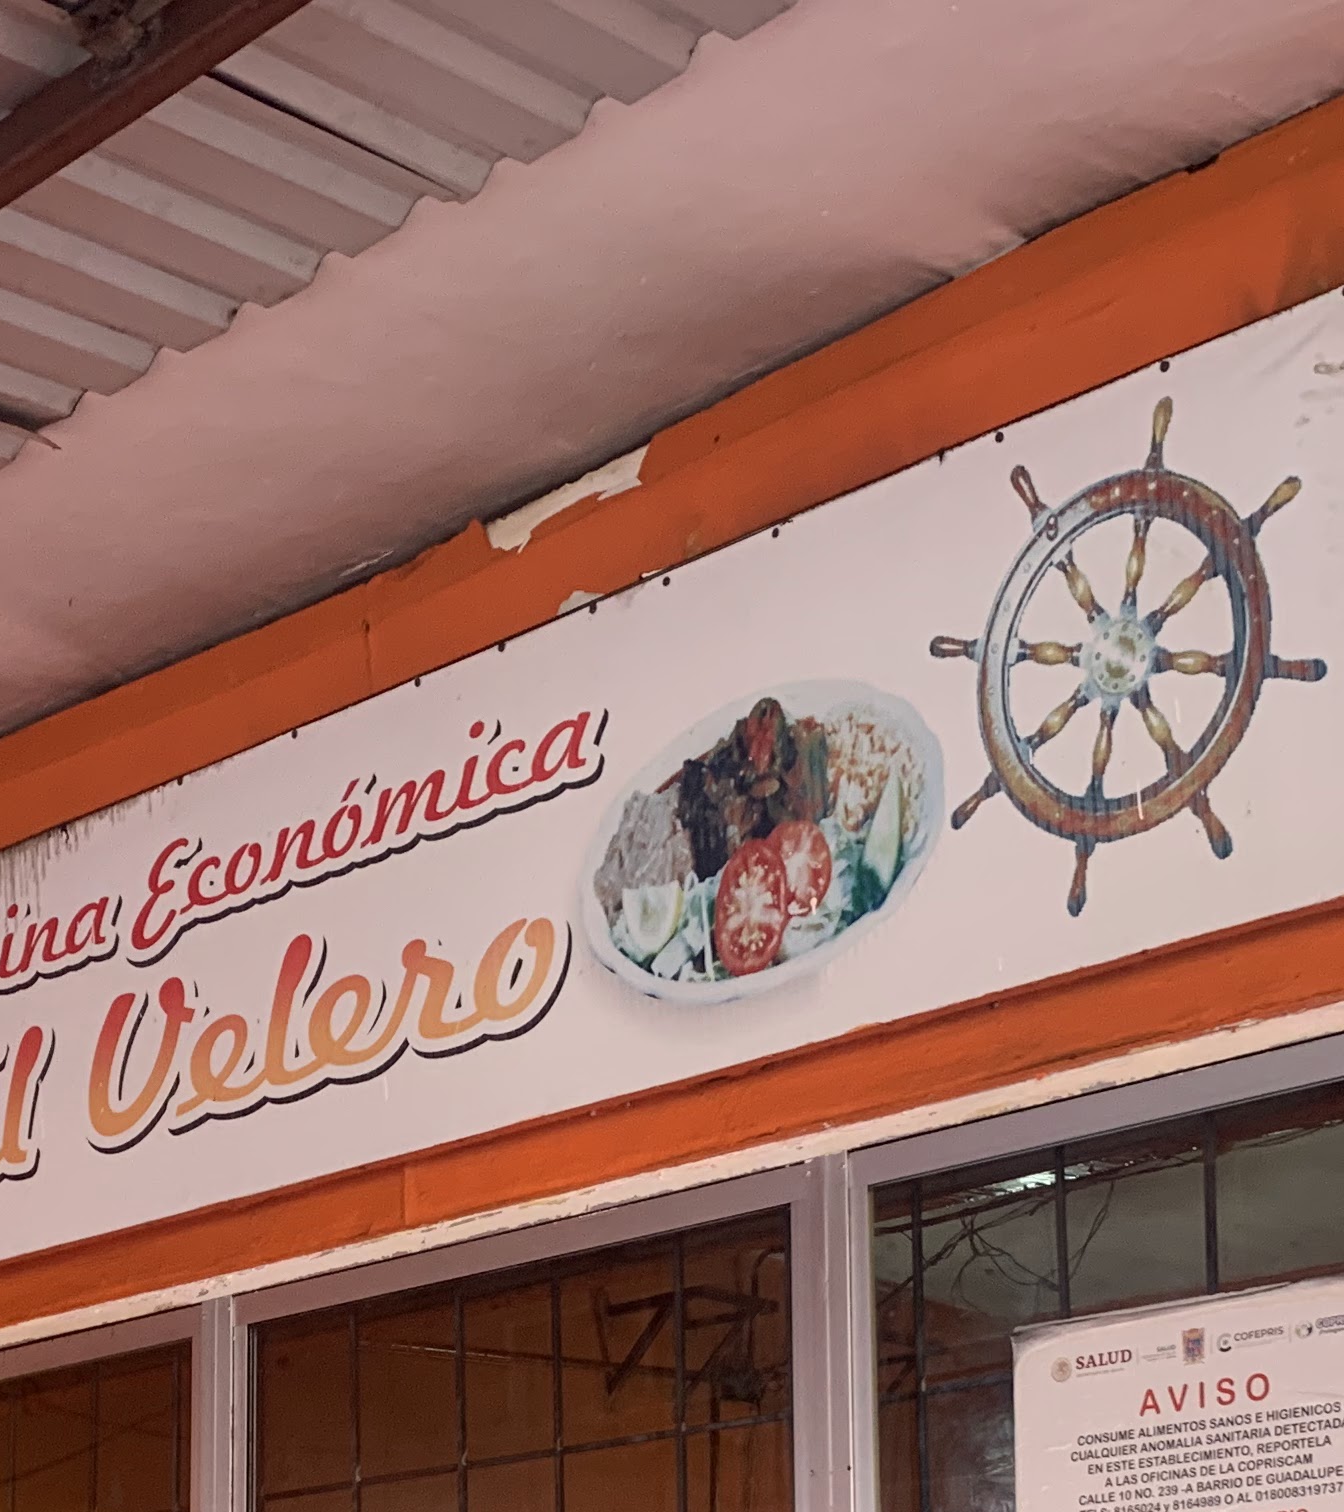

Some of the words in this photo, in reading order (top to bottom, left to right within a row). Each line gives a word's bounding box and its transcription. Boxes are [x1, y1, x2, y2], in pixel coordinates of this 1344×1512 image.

[127, 708, 608, 966] Económica
[86, 916, 571, 1153] Velero
[1234, 1326, 1284, 1341] COFEPRIS
[1075, 1349, 1132, 1370] SALUD
[1139, 1373, 1270, 1417] AVISO
[1077, 1429, 1135, 1446] CONSUME
[1138, 1420, 1206, 1438] ALIMENTOS
[1209, 1413, 1252, 1429] SANOS
[1255, 1412, 1263, 1423] E
[1266, 1402, 1342, 1421] HIGIENICOS
[1071, 1444, 1137, 1462] CUALQUIER
[1140, 1436, 1203, 1453] ANOMALIA
[1206, 1428, 1271, 1445] SANITARIA
[1088, 1464, 1103, 1475] EN
[1106, 1459, 1135, 1473] ESTE
[1138, 1445, 1254, 1468] ESTABLECIMIENTO,
[1257, 1435, 1332, 1454] REPORTELA
[1079, 1492, 1115, 1506] CALLE
[1119, 1490, 1131, 1501] 10
[1135, 1488, 1154, 1500] NO.
[1158, 1485, 1178, 1497] 239
[1196, 1478, 1242, 1492] BARRIO
[1246, 1475, 1263, 1487] DE
[1266, 1465, 1344, 1484] GUADALUPE
[1105, 1477, 1113, 1487] A
[1116, 1474, 1137, 1487] LAS
[1141, 1467, 1196, 1484] OFICINAS
[1200, 1465, 1216, 1477] DE
[1219, 1463, 1235, 1474] LA
[1238, 1454, 1313, 1472] COPRISCAM
[1224, 1494, 1234, 1505] O
[1236, 1492, 1252, 1504] AL
